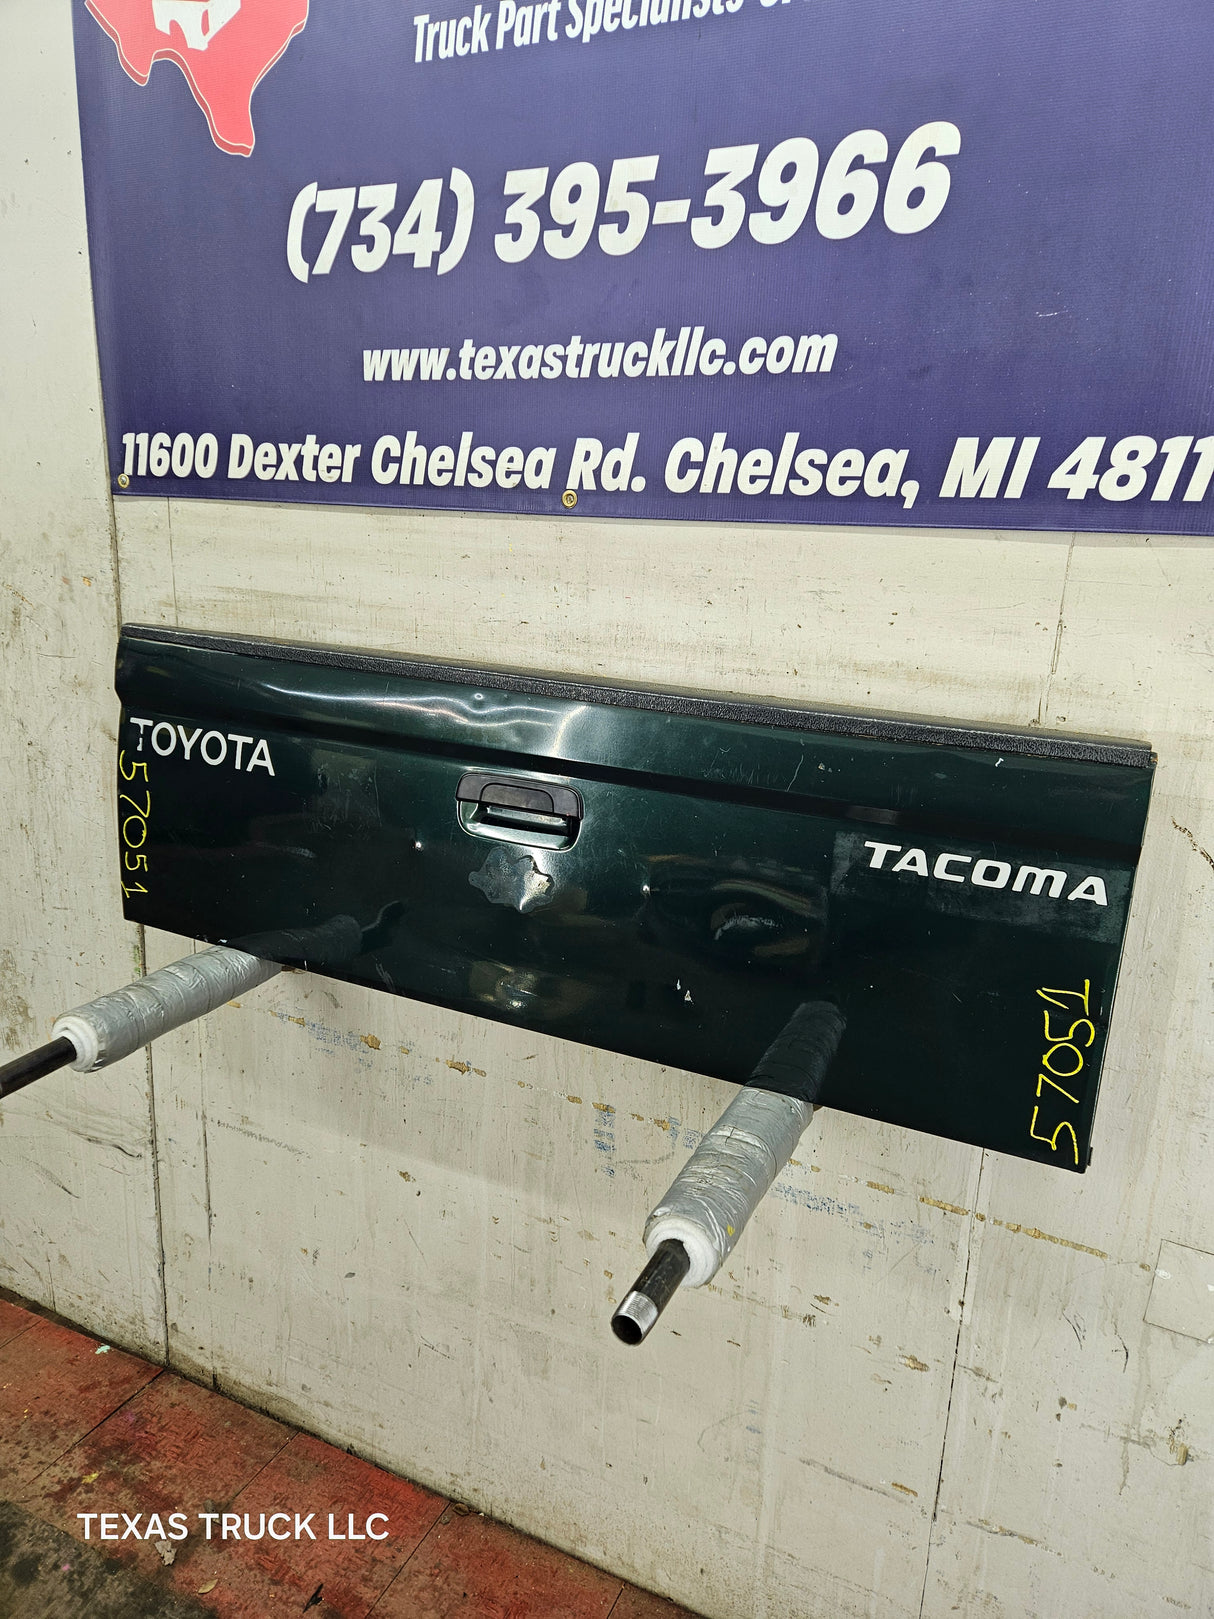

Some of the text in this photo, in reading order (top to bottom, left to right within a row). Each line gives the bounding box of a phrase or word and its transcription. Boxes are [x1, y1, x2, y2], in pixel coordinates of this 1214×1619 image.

[413, 4, 492, 63] Truck
[496, 0, 562, 50] Part
[287, 121, 961, 283] (734) 395-3966
[363, 326, 838, 382] www.texastruckllc.com
[122, 432, 219, 477] 11600
[228, 434, 361, 483] Dexter
[371, 431, 557, 489] Chelsea
[566, 432, 647, 492] Rd.
[664, 432, 919, 508] Chelsea,
[939, 437, 1041, 499] MI
[130, 718, 275, 777] TOYOTA
[119, 750, 150, 899] 57051
[864, 840, 1108, 906] TACOMA
[1030, 979, 1095, 1165] 57051
